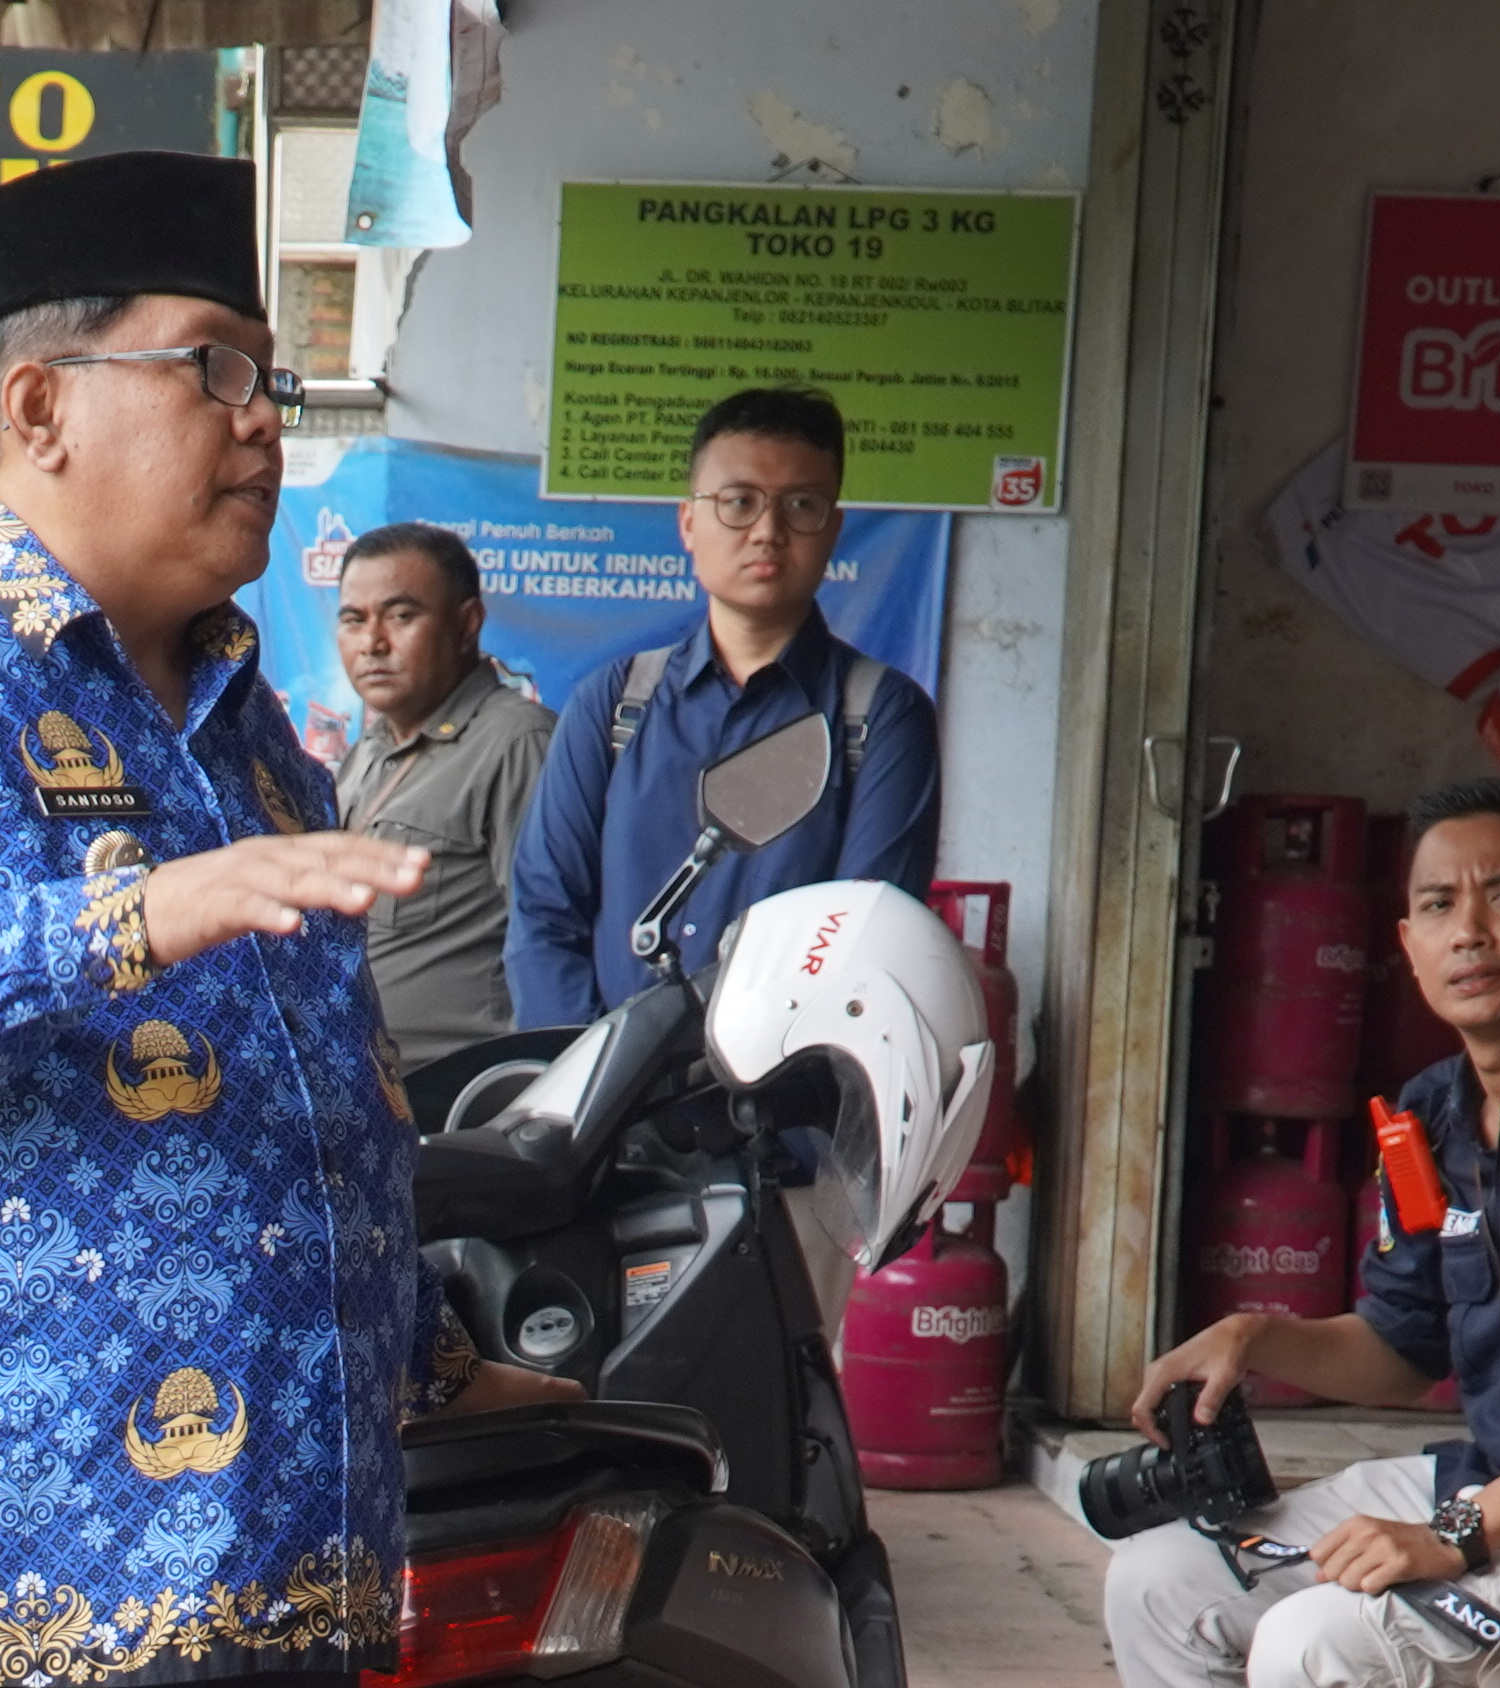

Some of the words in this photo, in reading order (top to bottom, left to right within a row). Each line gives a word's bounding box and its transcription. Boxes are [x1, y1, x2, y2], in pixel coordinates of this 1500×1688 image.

[638, 199, 836, 228] PANGKALAN
[849, 206, 911, 231] LPG
[922, 208, 939, 233] 3
[951, 210, 996, 234] KG
[746, 232, 835, 258] TOKO
[848, 236, 884, 260] 19
[559, 283, 662, 300] KELURAHAN
[1005, 297, 1066, 314] BLITAR
[564, 391, 618, 406] Kontak
[580, 411, 623, 427] Agen
[579, 428, 649, 447] Layanan
[577, 446, 609, 461] Call
[614, 448, 665, 463] Center
[577, 465, 609, 480] Call
[612, 466, 664, 482] Center
[481, 520, 541, 540] Penuh
[546, 522, 615, 543] Berkah
[511, 550, 600, 574] UNTUK
[605, 553, 686, 577] IRINGI
[523, 575, 697, 602] KEBERKAHAN
[55, 793, 136, 807] SANTOSO
[801, 911, 849, 976] VIAR
